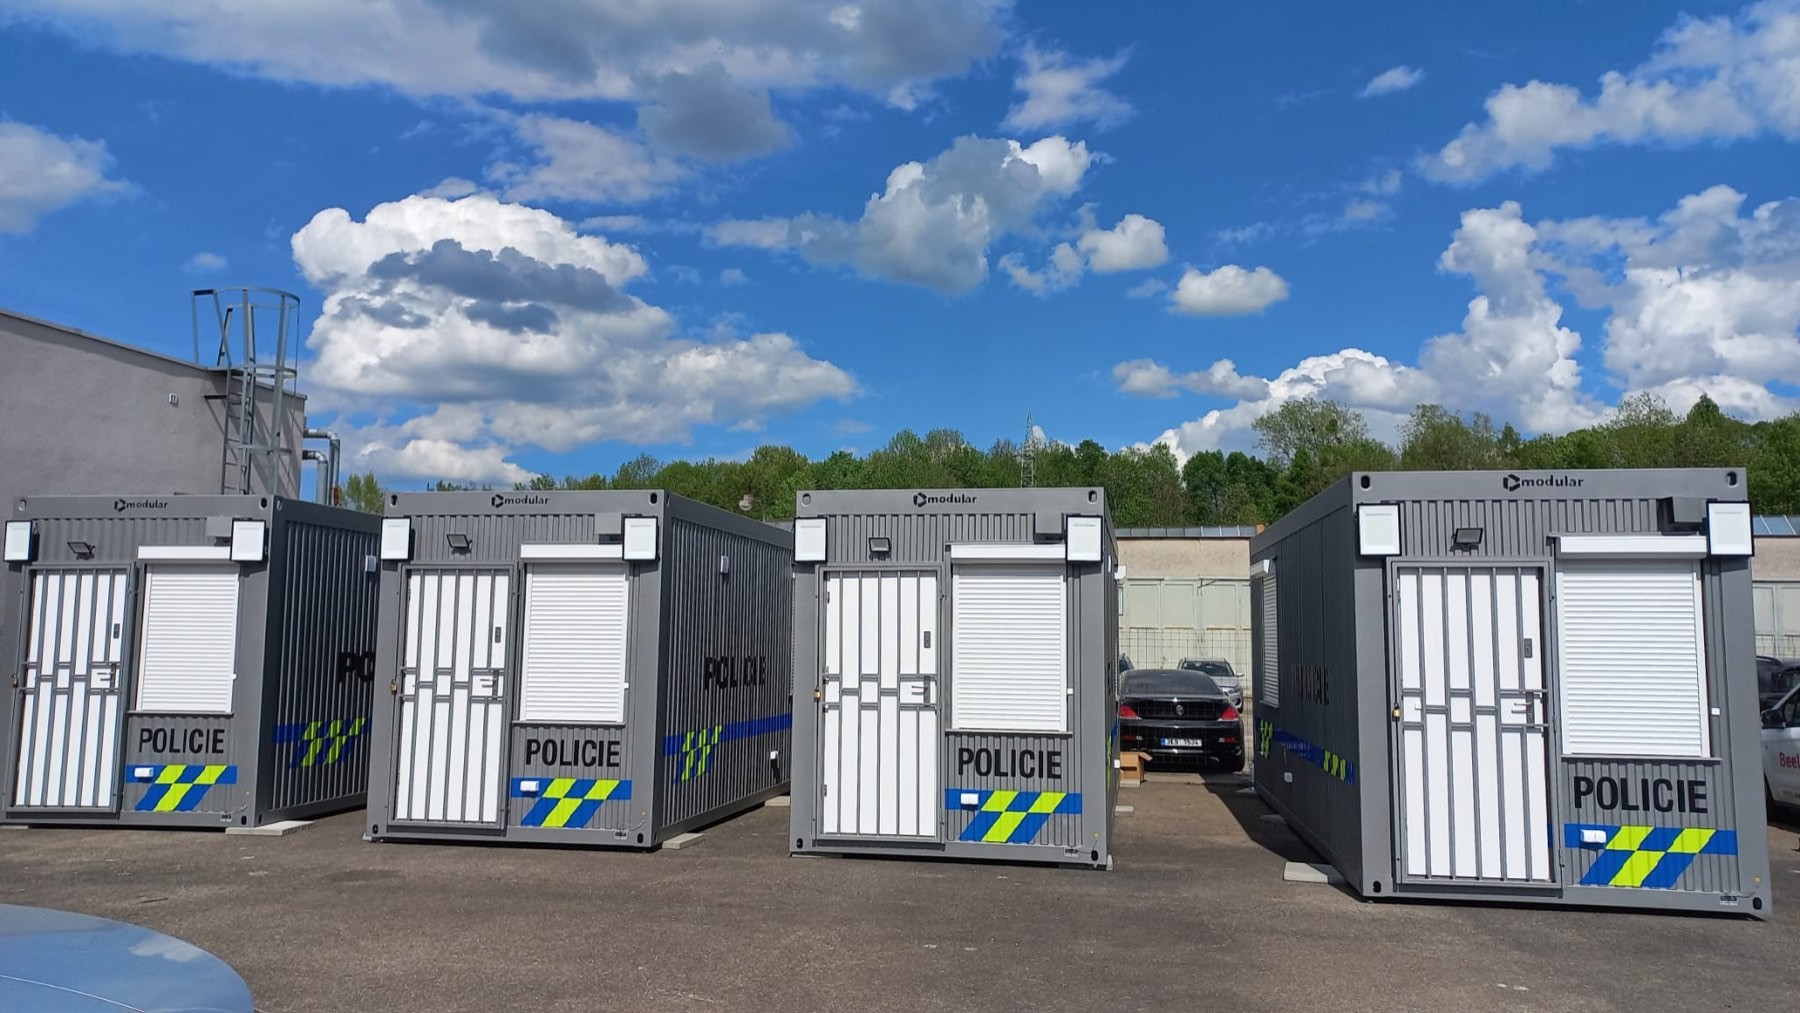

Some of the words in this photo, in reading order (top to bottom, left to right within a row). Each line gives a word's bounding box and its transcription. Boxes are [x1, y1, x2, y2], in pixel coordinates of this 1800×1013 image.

[1521, 474, 1585, 487] modular
[126, 499, 168, 509] modular
[504, 494, 549, 505] modular
[927, 492, 978, 504] modular
[704, 655, 767, 690] POLICIE
[138, 727, 225, 754] POLICIE
[525, 738, 620, 767] POLICIE
[958, 747, 1062, 779] POLICIE
[1573, 776, 1708, 814] POLICIE
